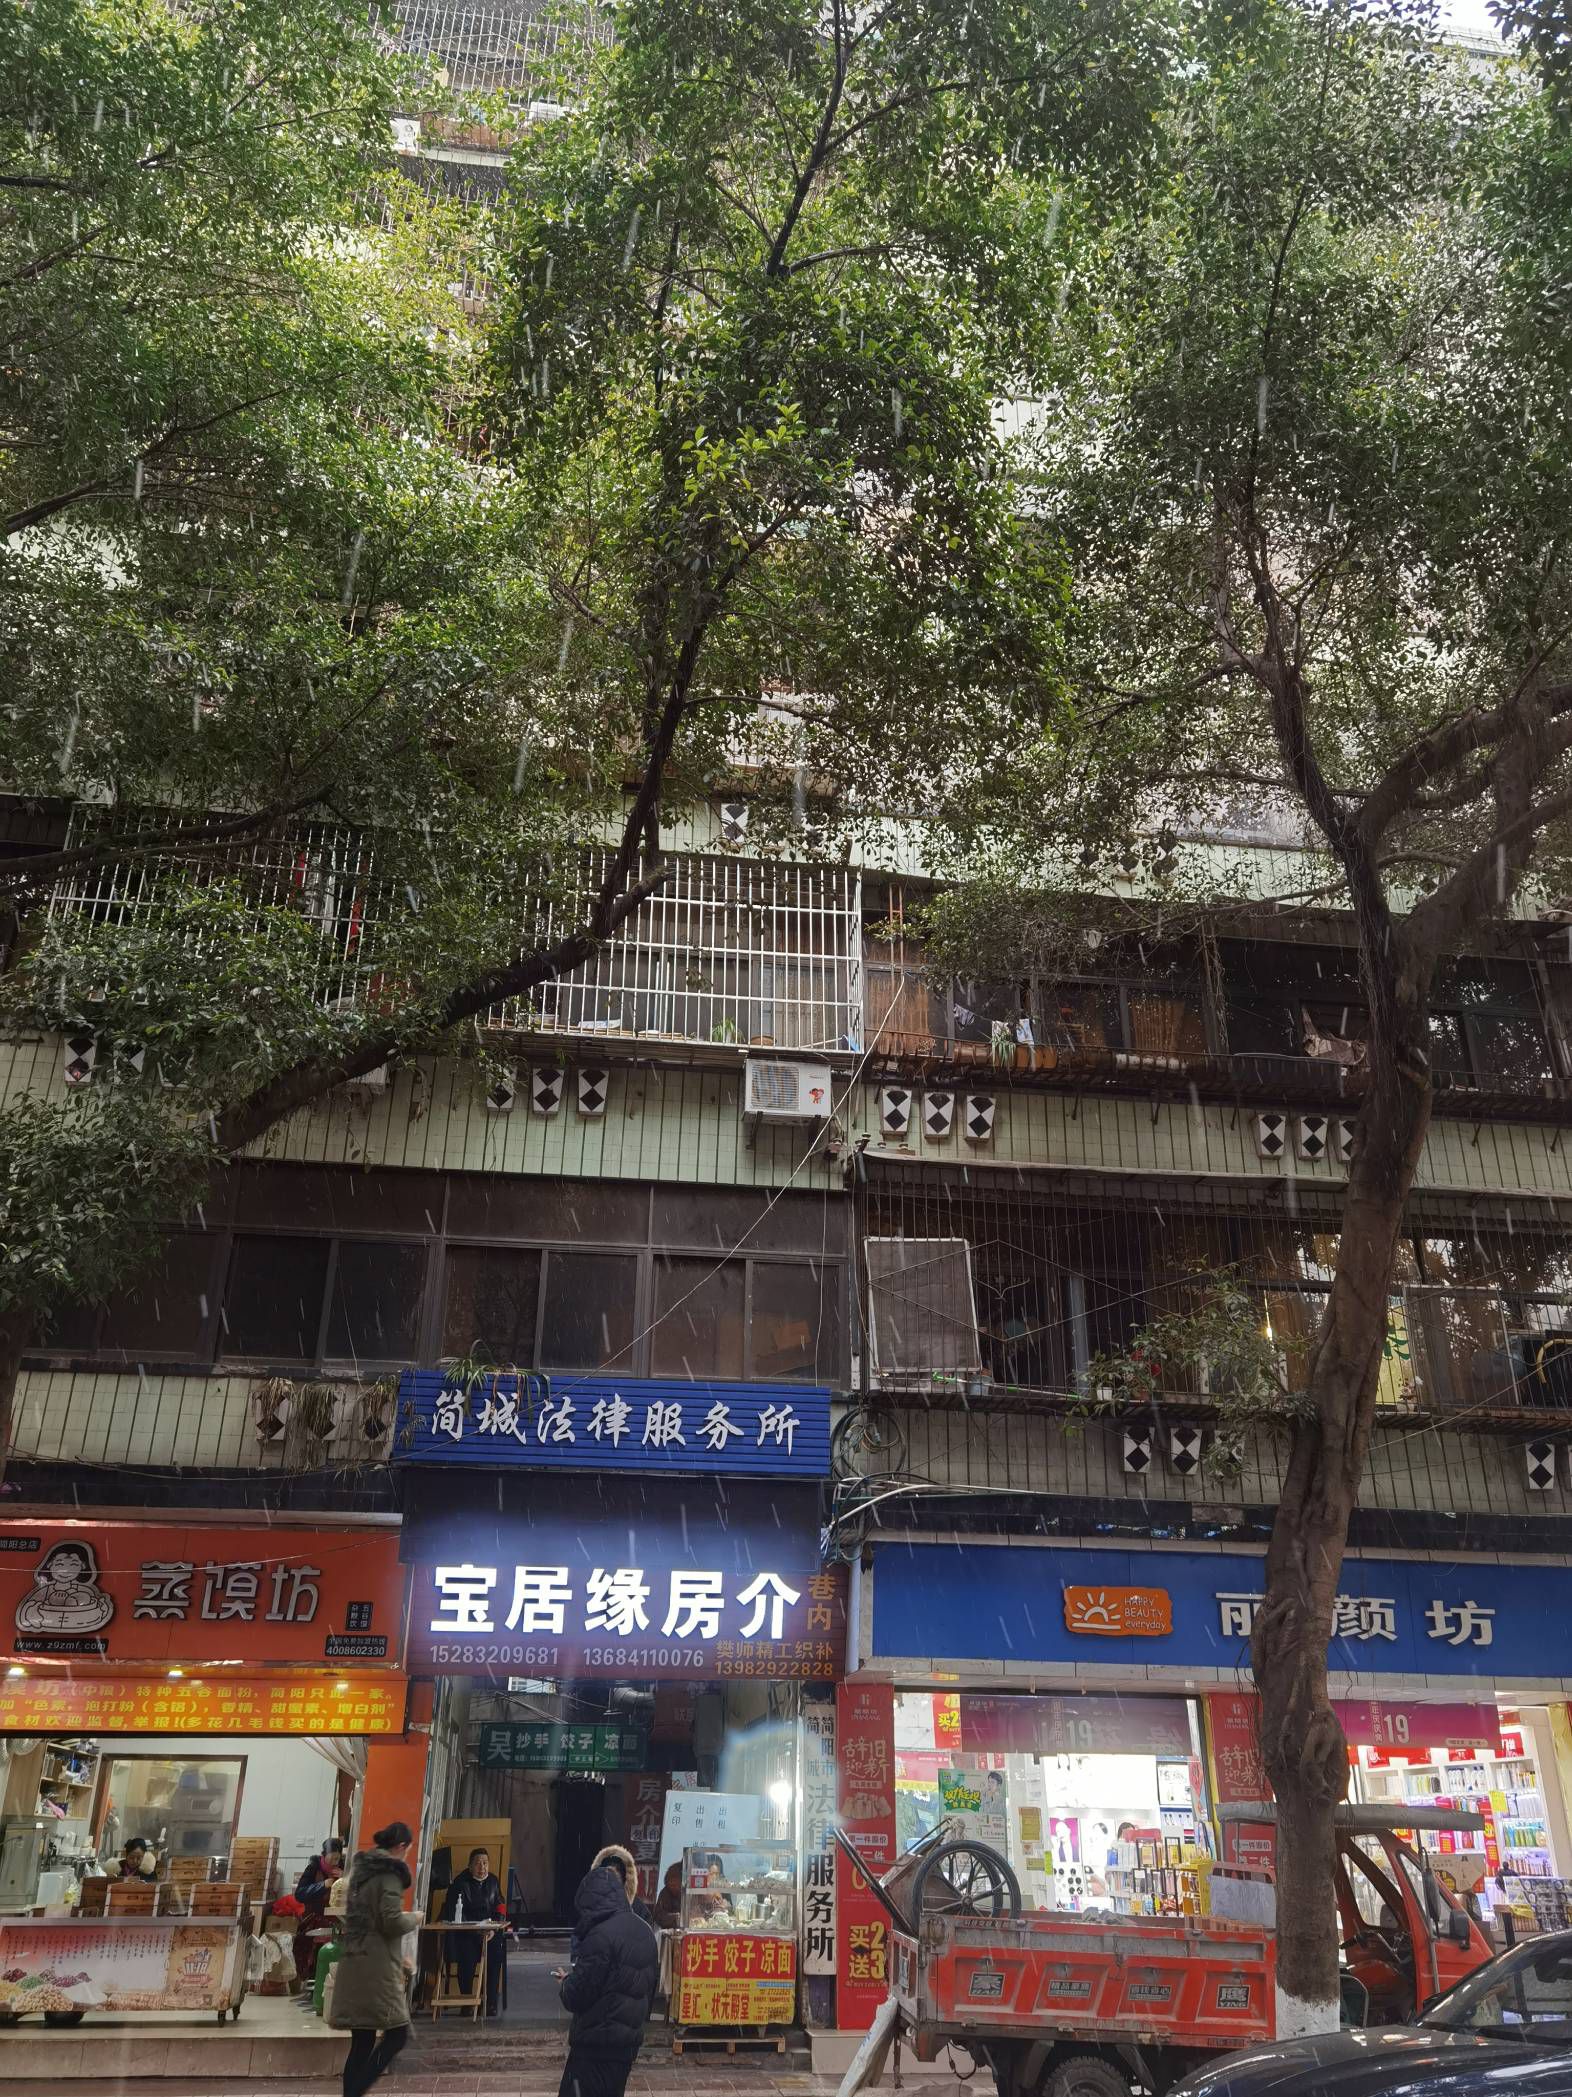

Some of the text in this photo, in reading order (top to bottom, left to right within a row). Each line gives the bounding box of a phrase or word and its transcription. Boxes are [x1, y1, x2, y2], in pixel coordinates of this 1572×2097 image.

[431, 1389, 800, 1456] 简城法律服务所
[133, 1560, 320, 1622] 蒸馍坊
[430, 1564, 801, 1639] 宝居缘房介
[807, 1574, 836, 1632] 巷内
[1125, 1596, 1154, 1606] HAPPY
[1125, 1608, 1163, 1617] BEAUTY
[1126, 1619, 1166, 1631] everyday
[326, 1646, 385, 1656] 4008602330
[430, 1645, 704, 1667] 15283209681 13684110076
[716, 1639, 833, 1660] 樊师精工织补
[716, 1661, 833, 1676] 13982922828
[1066, 1720, 1094, 1750] 19
[1384, 1714, 1410, 1743] 19
[487, 1731, 511, 1761] 吴
[516, 1732, 549, 1749] 抄手
[560, 1733, 593, 1750] 饺子
[604, 1733, 638, 1750] 凉面
[821, 1716, 834, 1777] 简阳市
[842, 1736, 887, 1760] 辞旧
[845, 1759, 890, 1784] 迎新
[805, 1783, 836, 1962] 法律服务所
[850, 1921, 885, 1949] 买2
[687, 1939, 793, 1975] 抄手 饺子 凉面
[849, 1951, 886, 1979] 送3
